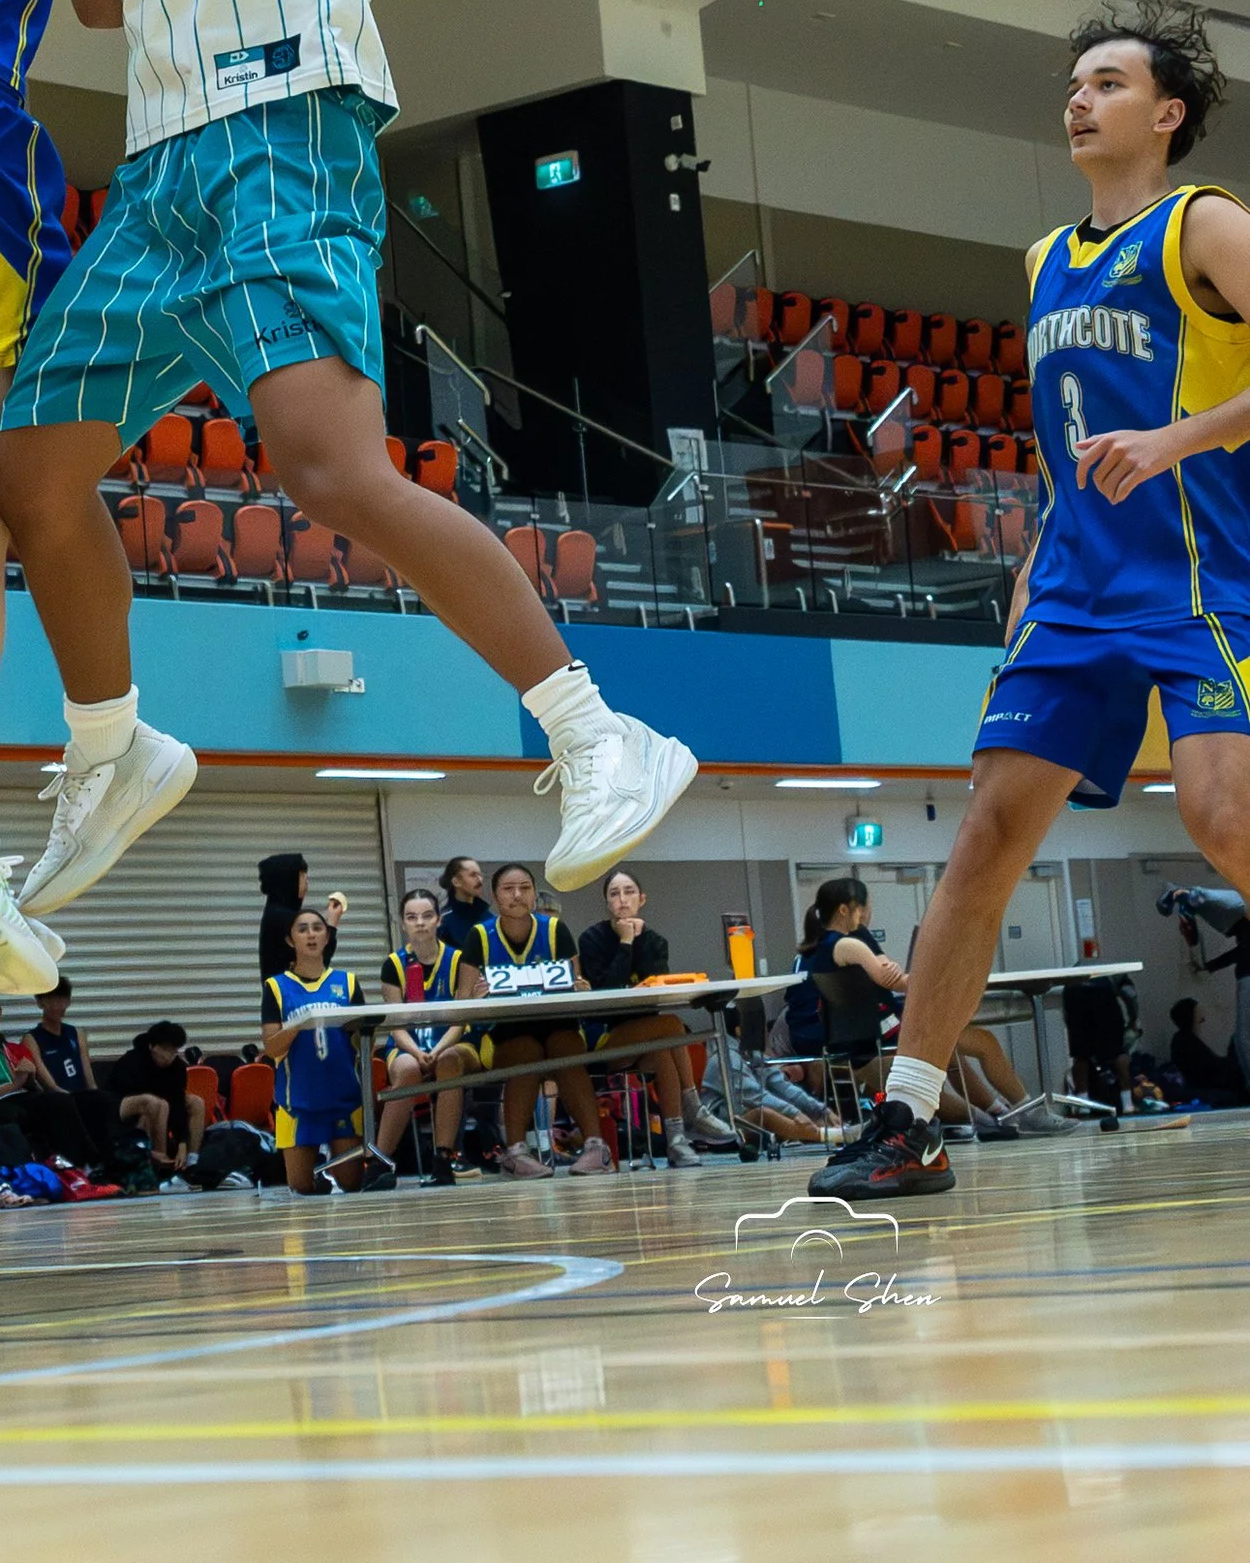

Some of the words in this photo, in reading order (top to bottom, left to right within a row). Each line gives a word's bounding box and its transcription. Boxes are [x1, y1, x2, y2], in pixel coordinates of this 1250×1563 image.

[224, 70, 259, 85] Kristin
[1060, 372, 1090, 463] 3
[491, 970, 513, 990] 2
[546, 965, 569, 986] 2
[63, 1058, 77, 1078] 6
